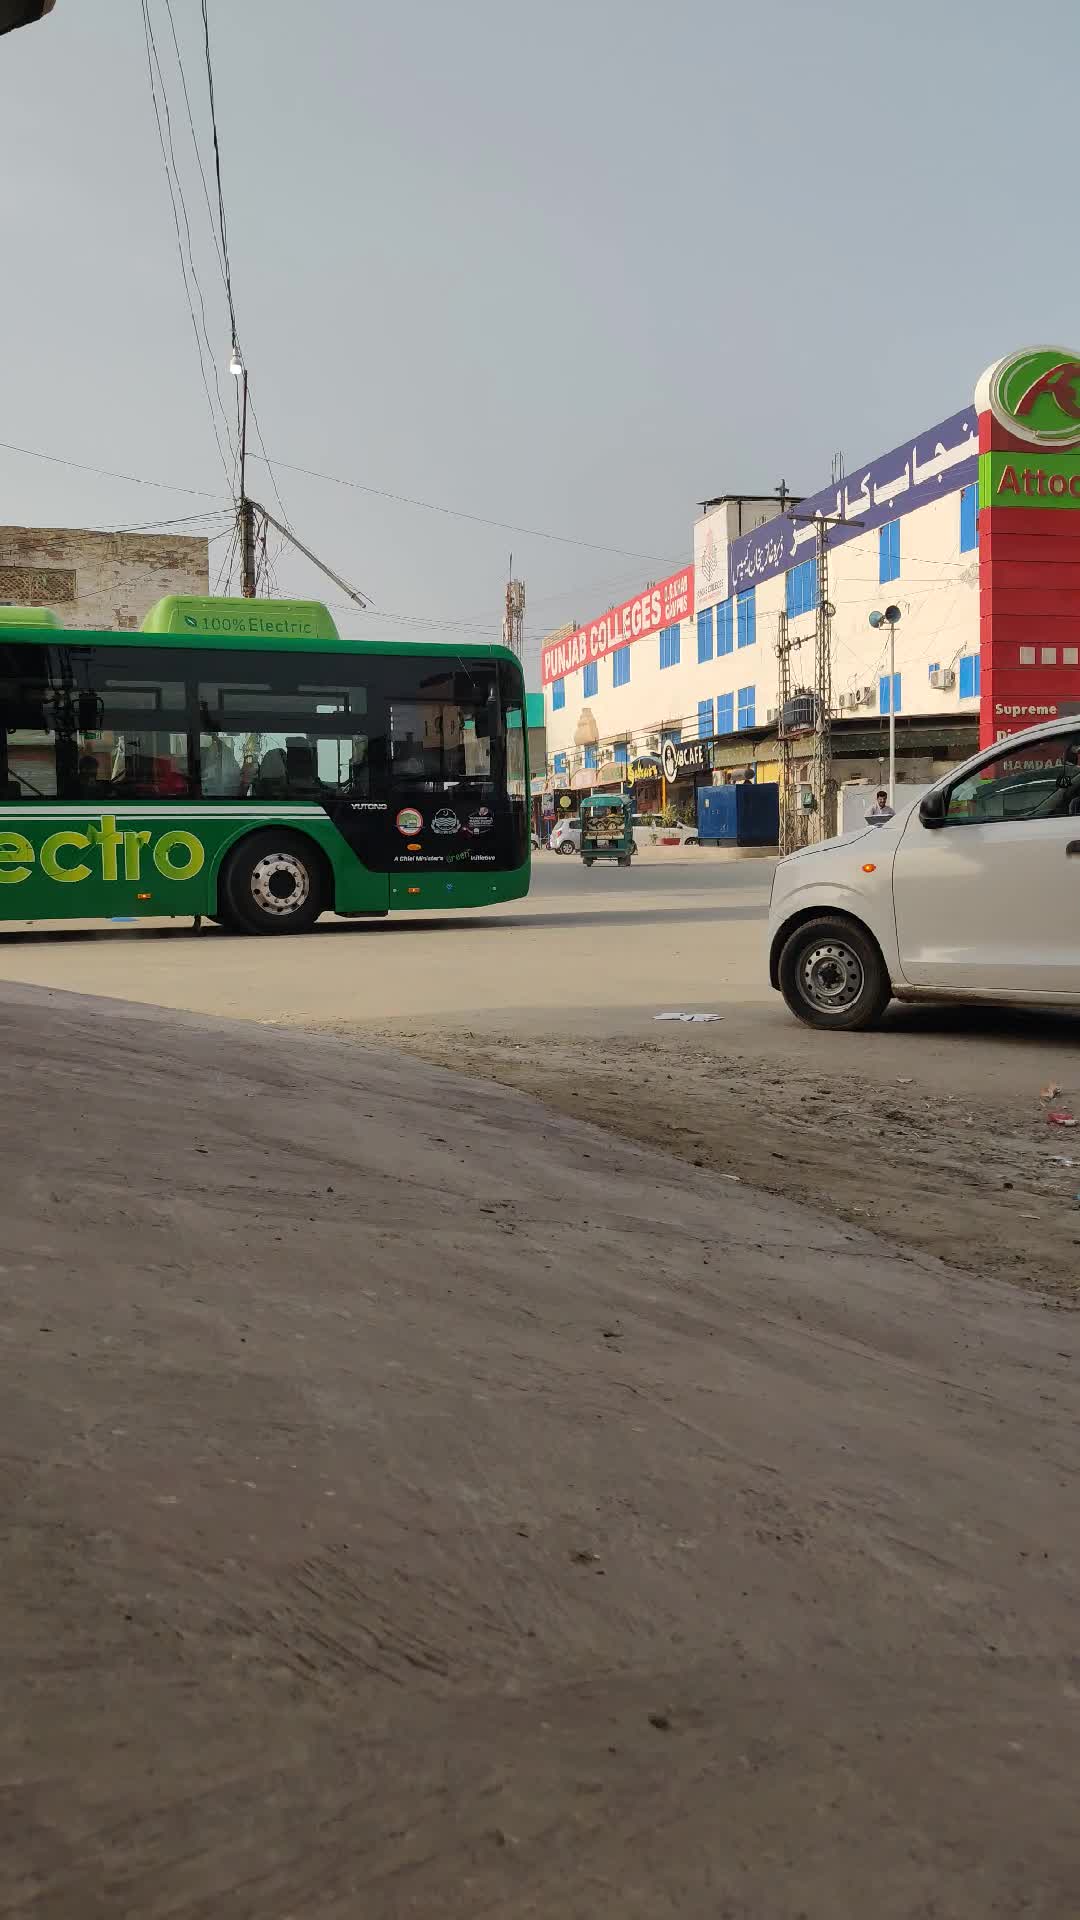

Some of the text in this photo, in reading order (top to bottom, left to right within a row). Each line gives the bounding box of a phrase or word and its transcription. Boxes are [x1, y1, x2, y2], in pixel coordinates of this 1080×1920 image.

[665, 594, 688, 620] CAMPUS
[201, 617, 312, 634] 100% Electric
[544, 590, 662, 680] PUNJAB COLLEGES
[995, 703, 1058, 717] Supreme
